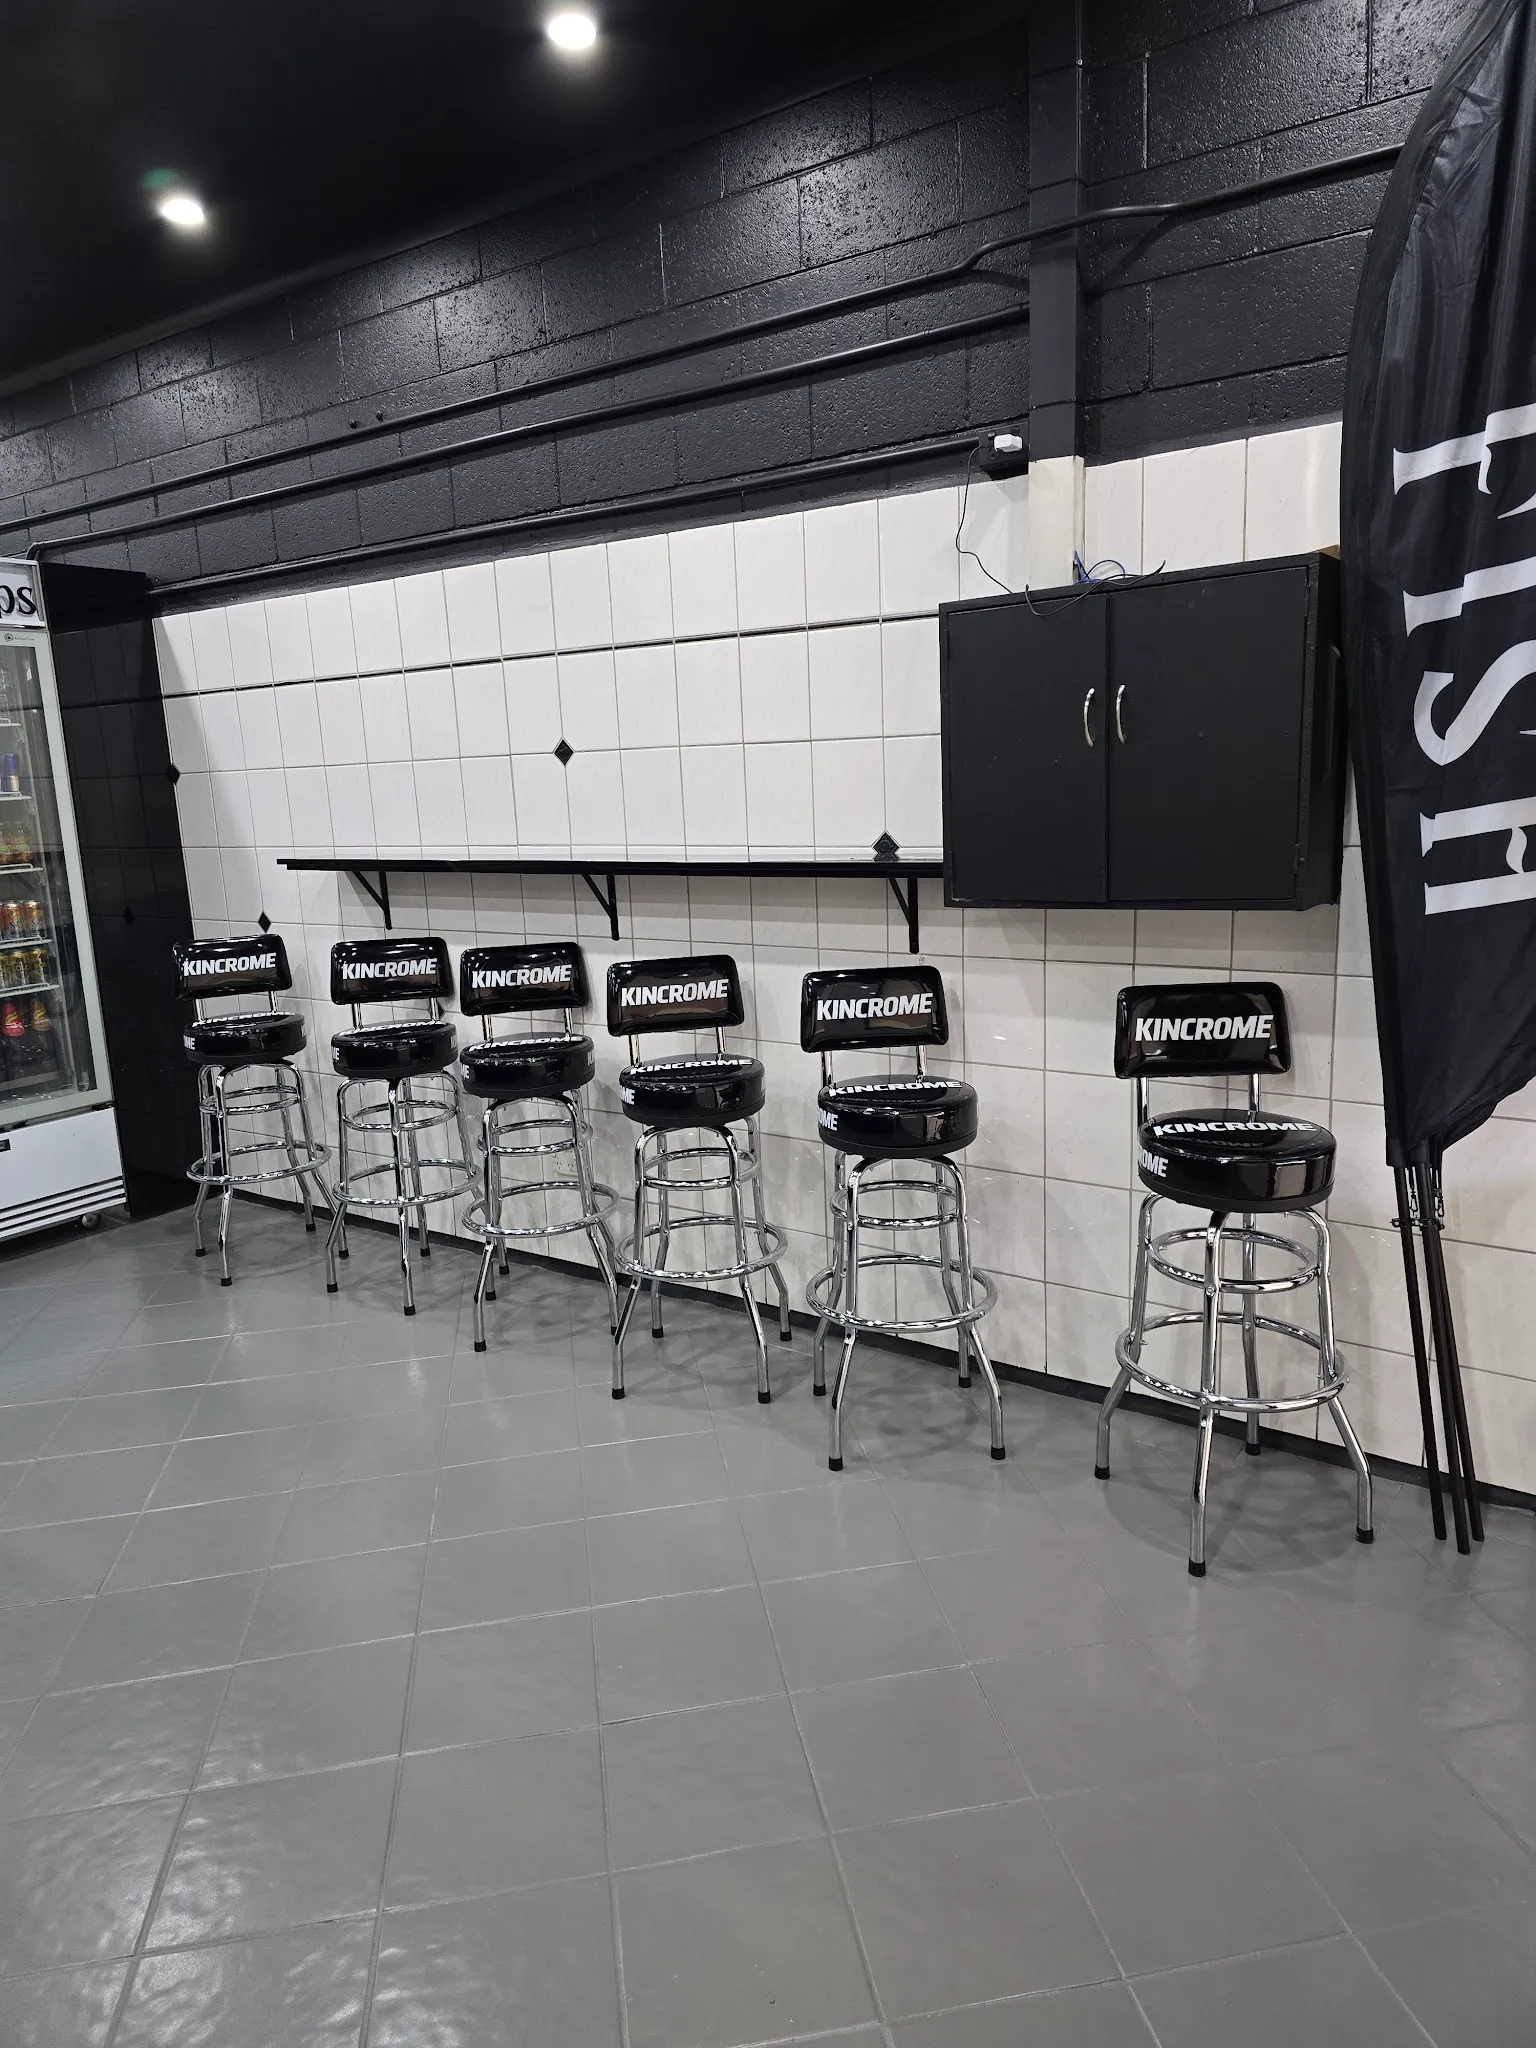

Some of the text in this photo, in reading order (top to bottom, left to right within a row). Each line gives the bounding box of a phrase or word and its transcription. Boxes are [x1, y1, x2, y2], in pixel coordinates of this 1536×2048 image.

[183, 952, 277, 977] KINCROME
[342, 958, 438, 980] KINCROME
[471, 964, 573, 989] KINCROME
[621, 978, 730, 1007] KINCROME
[816, 992, 934, 1021] KINCROME
[1135, 1014, 1275, 1042] KINCROME
[629, 1059, 754, 1076] KINCROME
[828, 1081, 963, 1097] KINCROME
[1152, 1121, 1318, 1138] KINCROME
